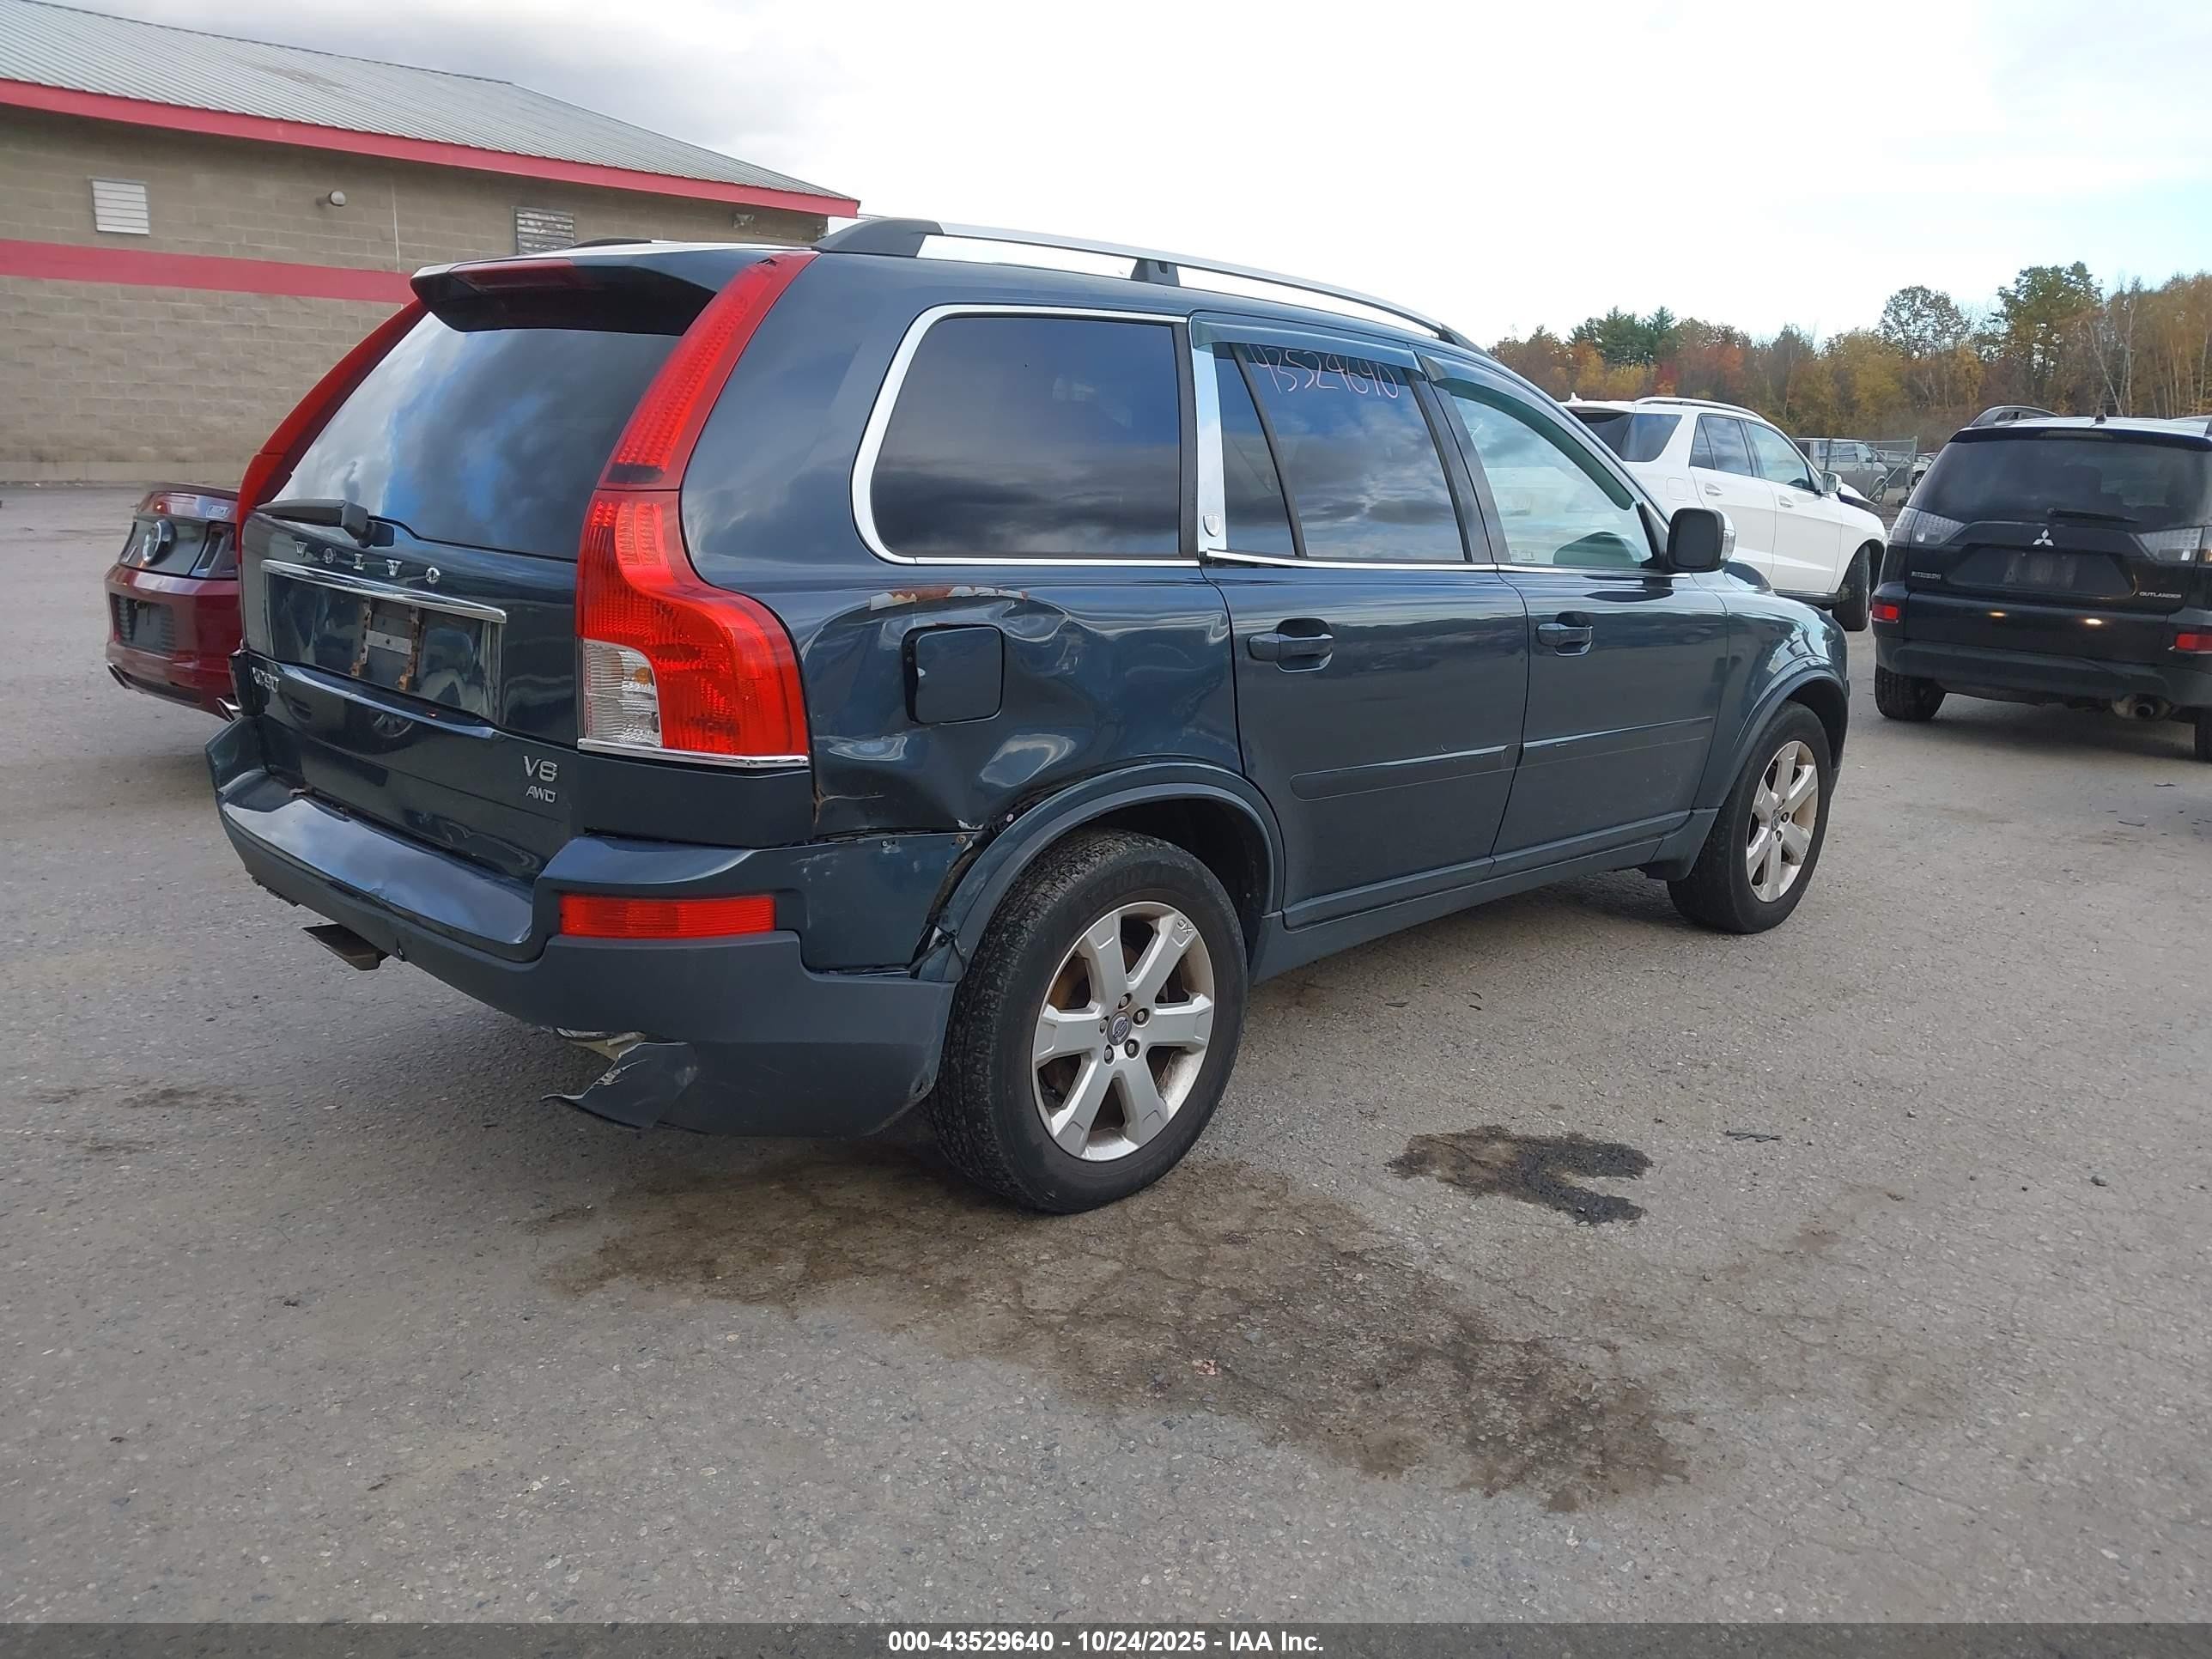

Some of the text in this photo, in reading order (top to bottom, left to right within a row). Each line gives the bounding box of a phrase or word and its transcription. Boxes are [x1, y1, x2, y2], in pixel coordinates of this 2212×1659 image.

[1247, 343, 1399, 399] 43529640
[295, 541, 441, 585] VOLVO
[523, 756, 558, 782] V8
[526, 786, 556, 803] AWD
